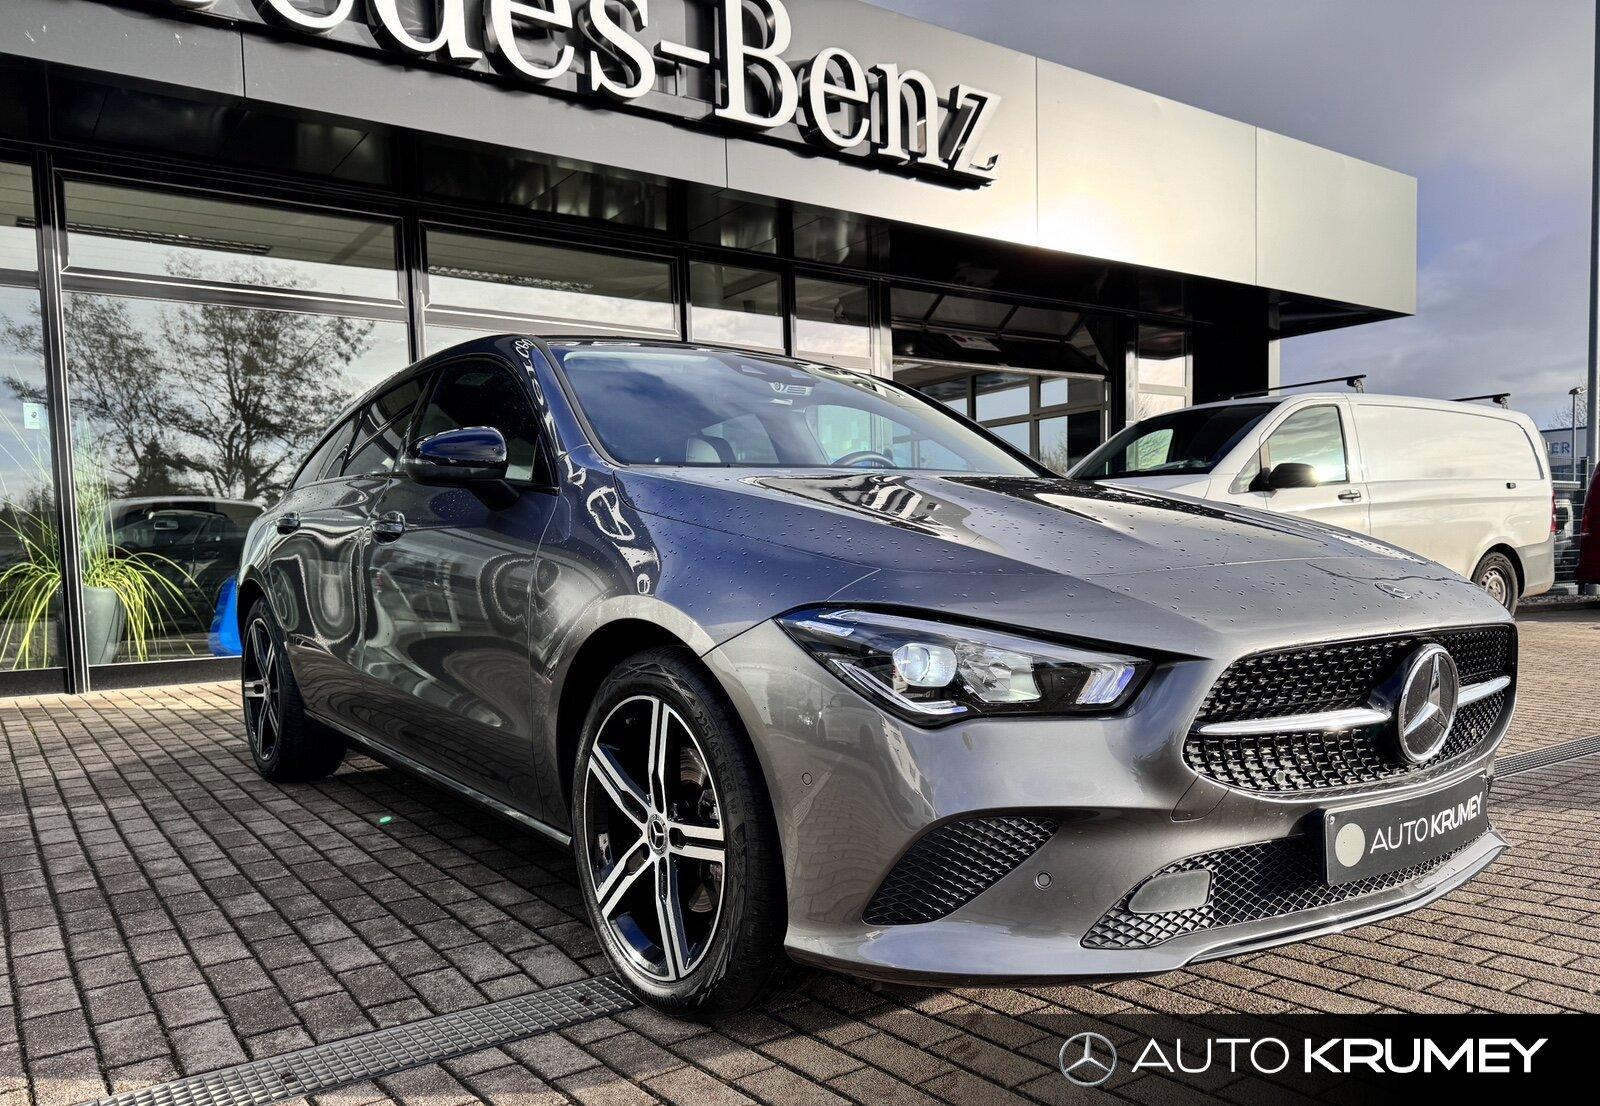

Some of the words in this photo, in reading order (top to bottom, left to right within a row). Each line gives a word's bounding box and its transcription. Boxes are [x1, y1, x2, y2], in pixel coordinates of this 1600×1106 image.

[1551, 441, 1570, 454] ER
[1370, 817, 1428, 854] AUTO
[1430, 791, 1483, 838] KRUMEY
